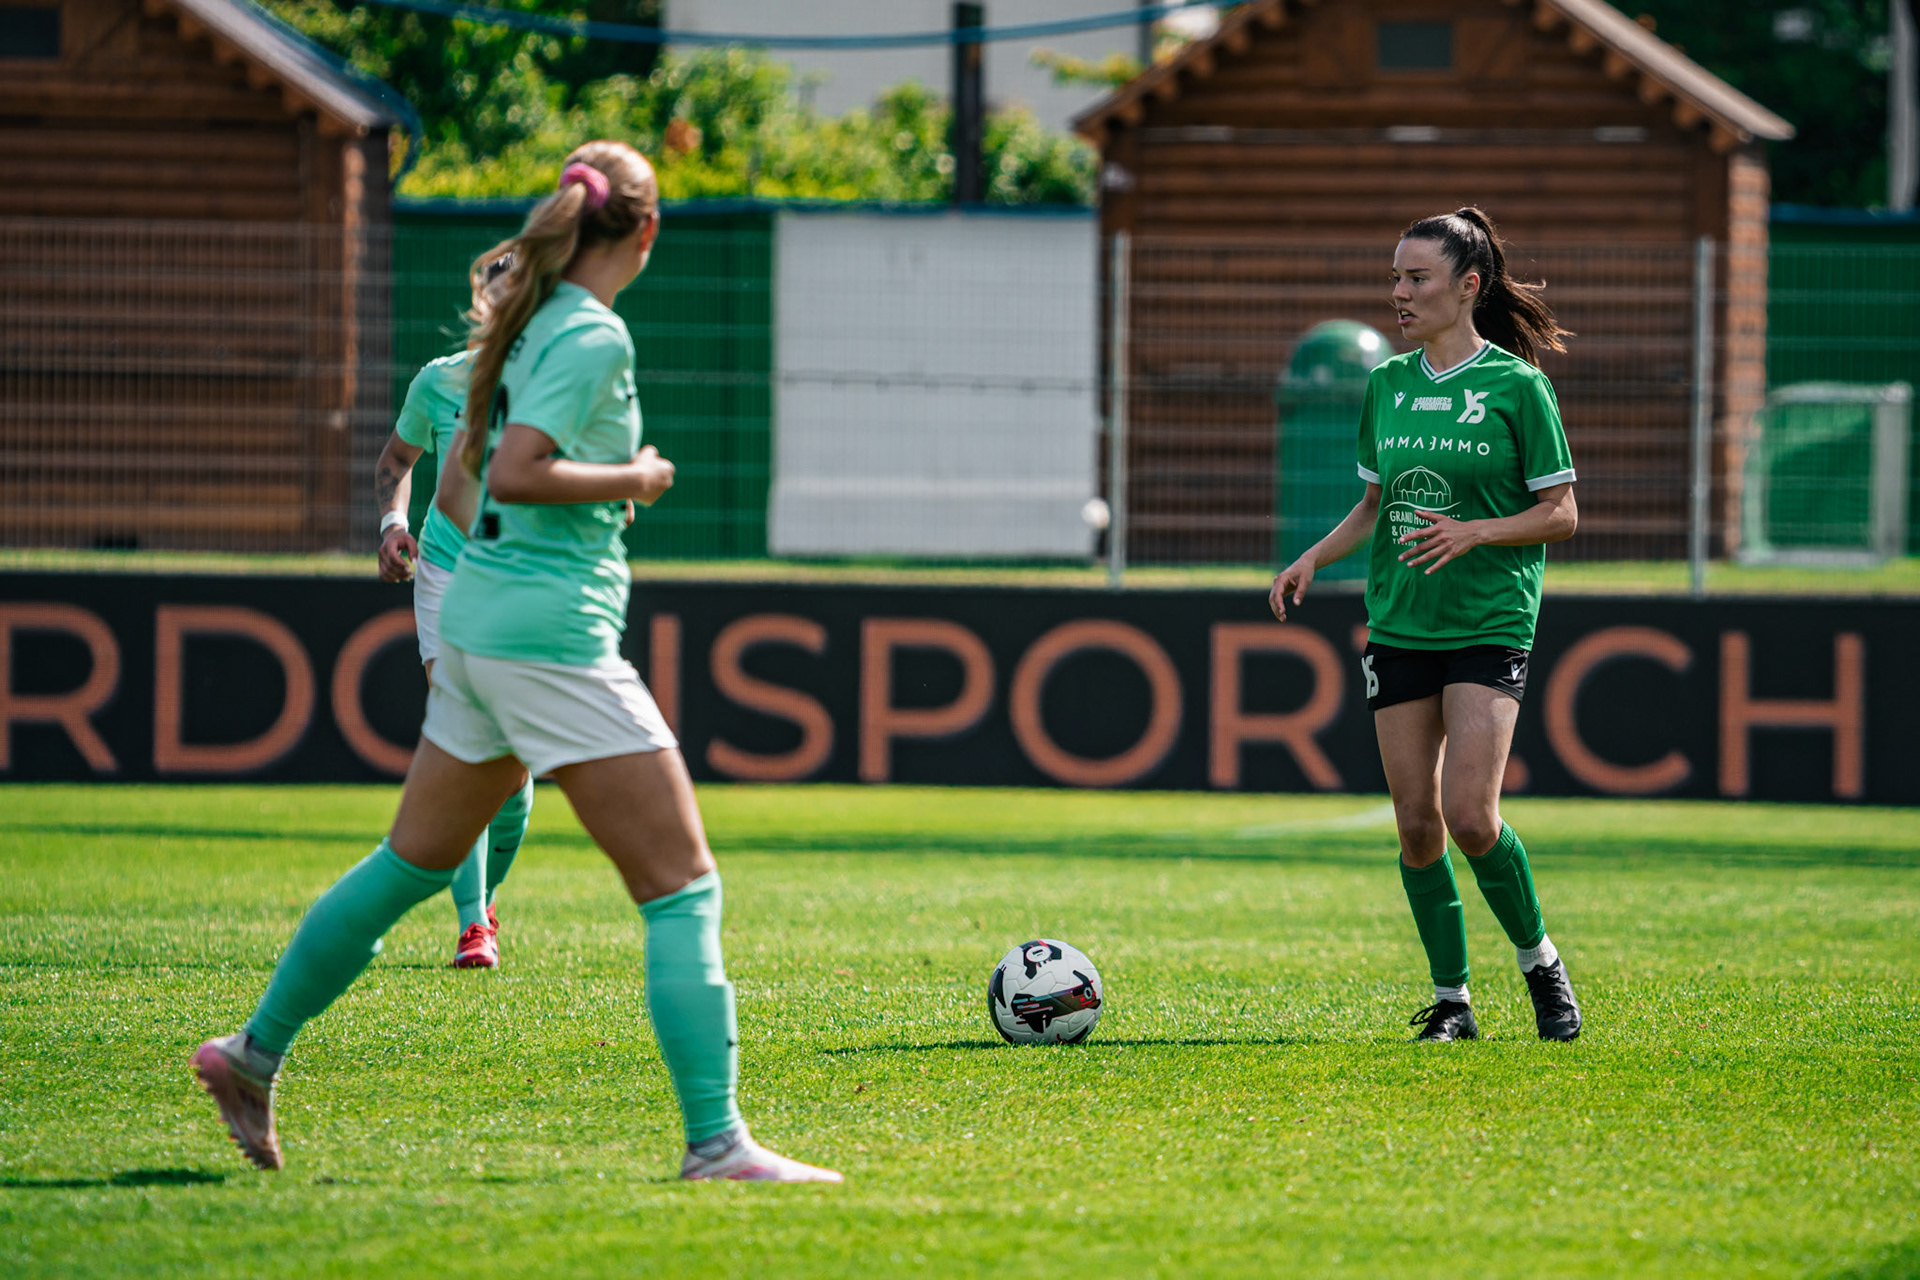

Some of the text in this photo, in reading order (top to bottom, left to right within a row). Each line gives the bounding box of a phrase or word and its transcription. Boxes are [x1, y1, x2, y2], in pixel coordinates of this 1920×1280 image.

[1418, 403, 1453, 411] PROMOTION
[1389, 510, 1413, 524] GRAND
[1391, 525, 1398, 536] &
